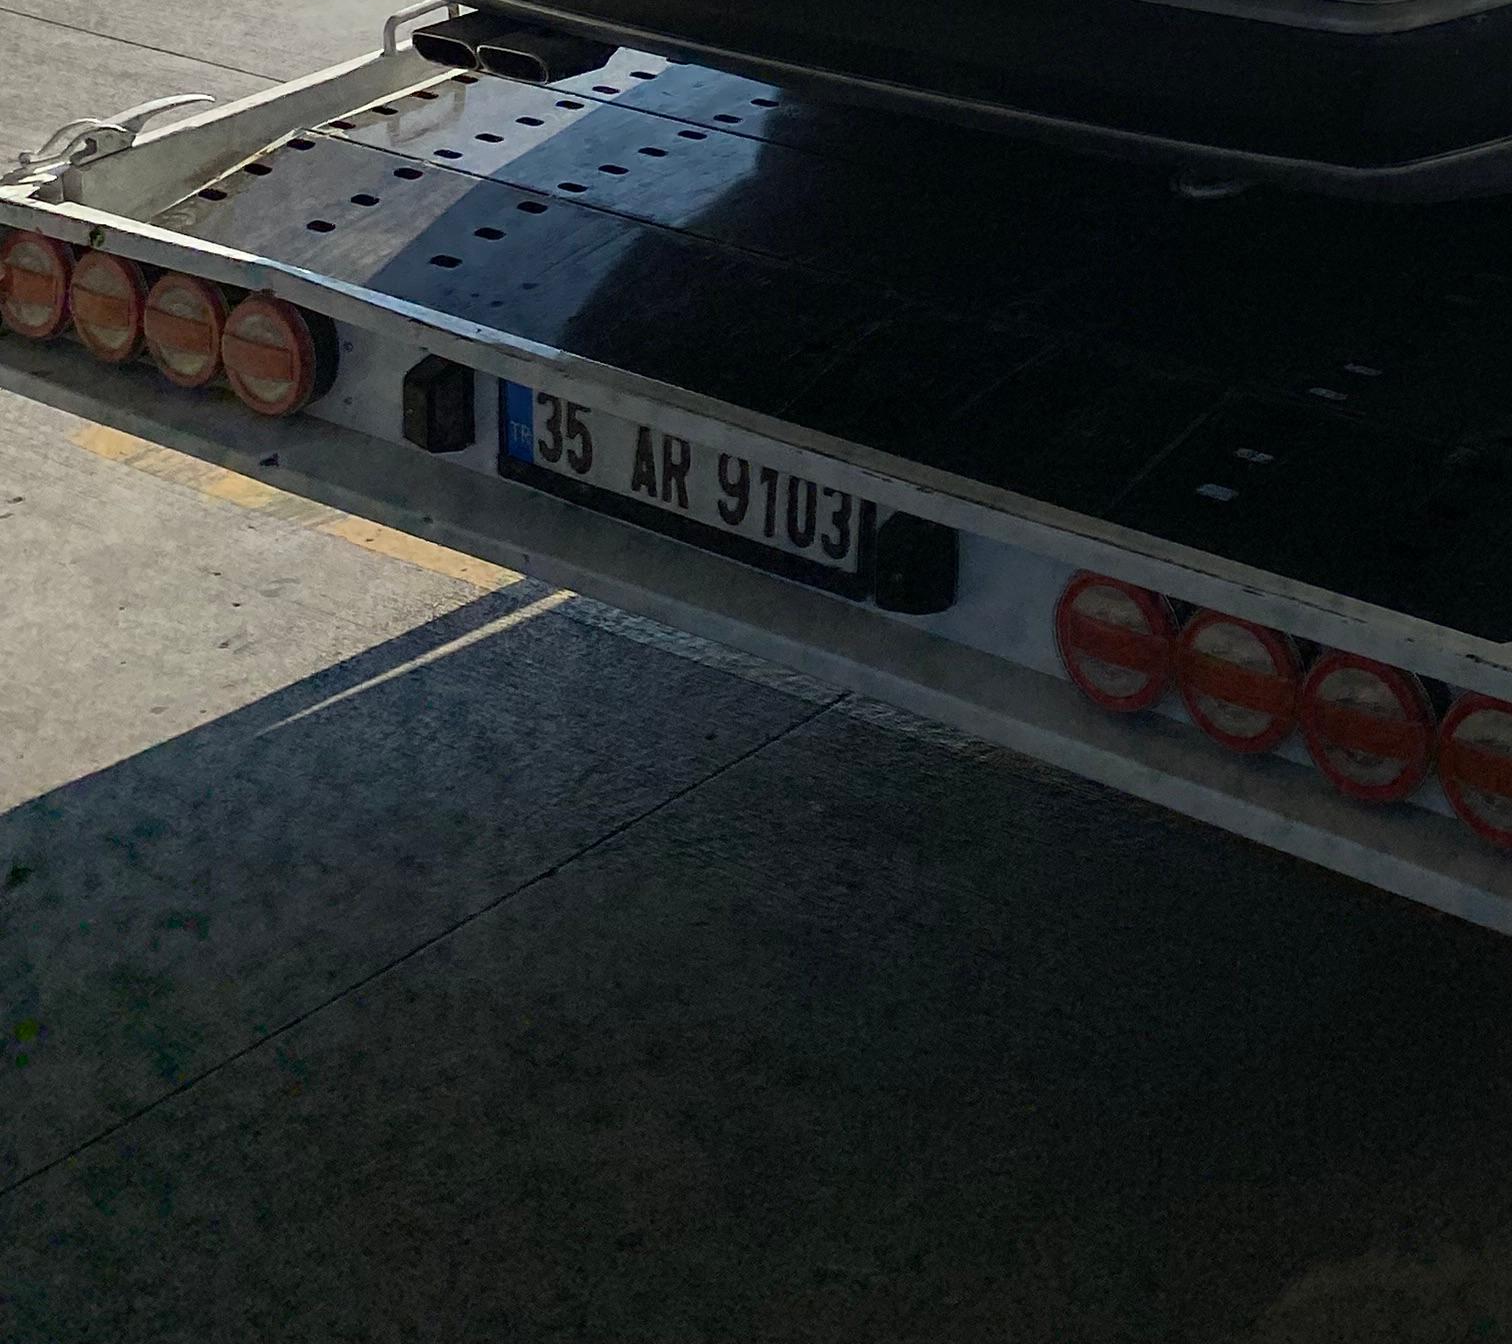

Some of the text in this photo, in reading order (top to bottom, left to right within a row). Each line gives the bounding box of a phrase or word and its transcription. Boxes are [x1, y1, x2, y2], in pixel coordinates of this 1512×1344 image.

[536, 390, 852, 560] 35 AR 9103
